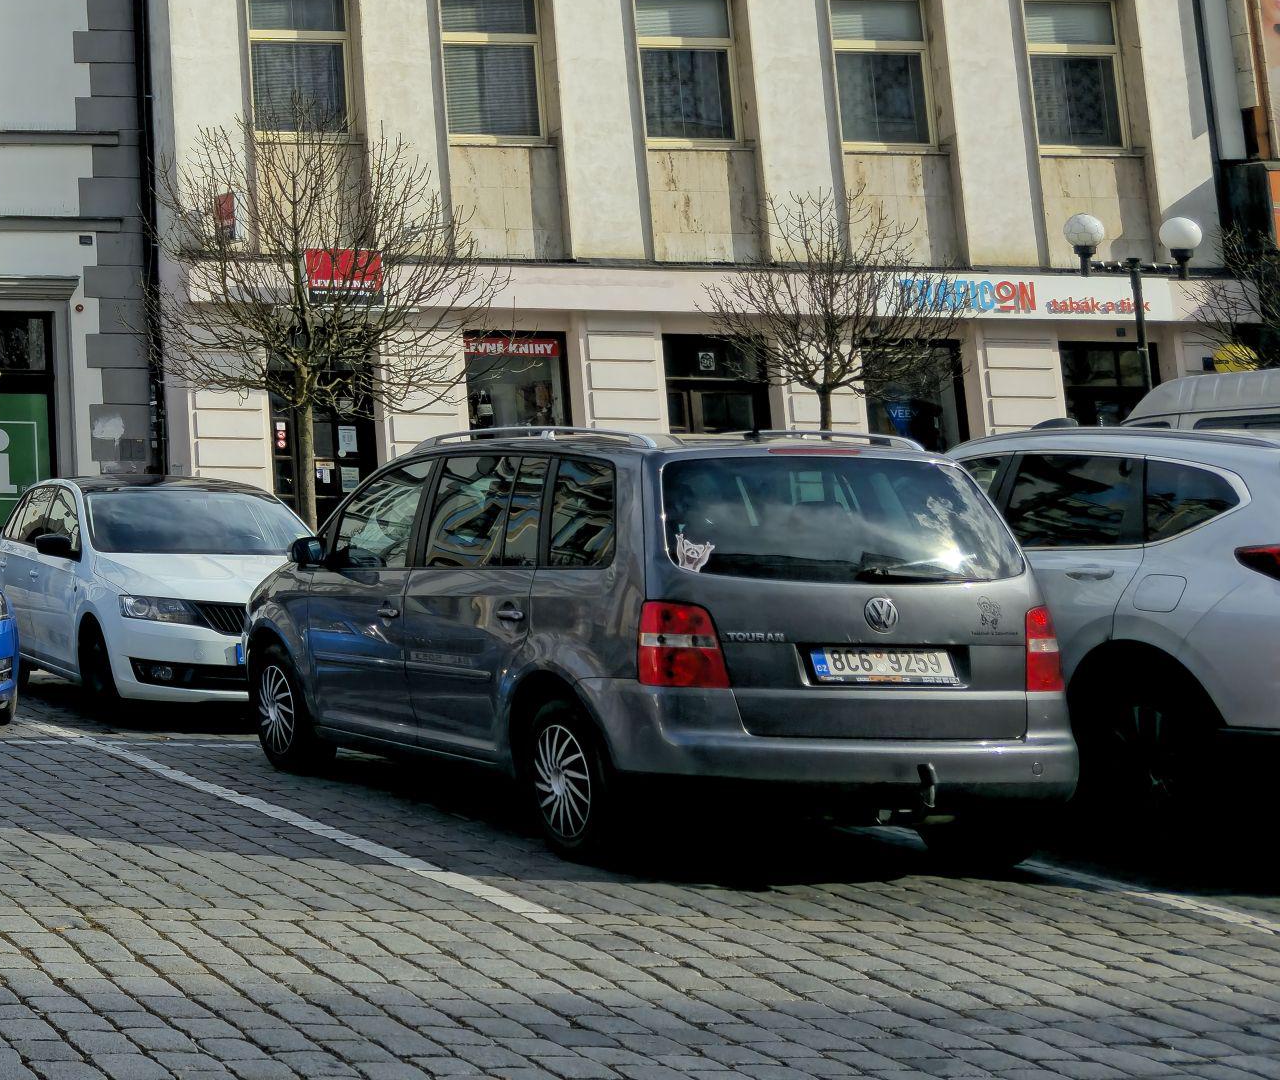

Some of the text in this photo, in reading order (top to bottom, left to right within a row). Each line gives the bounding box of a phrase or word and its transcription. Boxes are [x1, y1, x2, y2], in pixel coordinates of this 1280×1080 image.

[1120, 298, 1151, 312] tik
[464, 341, 554, 354] LEVNÉ KNIHY
[727, 632, 784, 642] TOURAN
[831, 650, 942, 674] 8C6 9259
